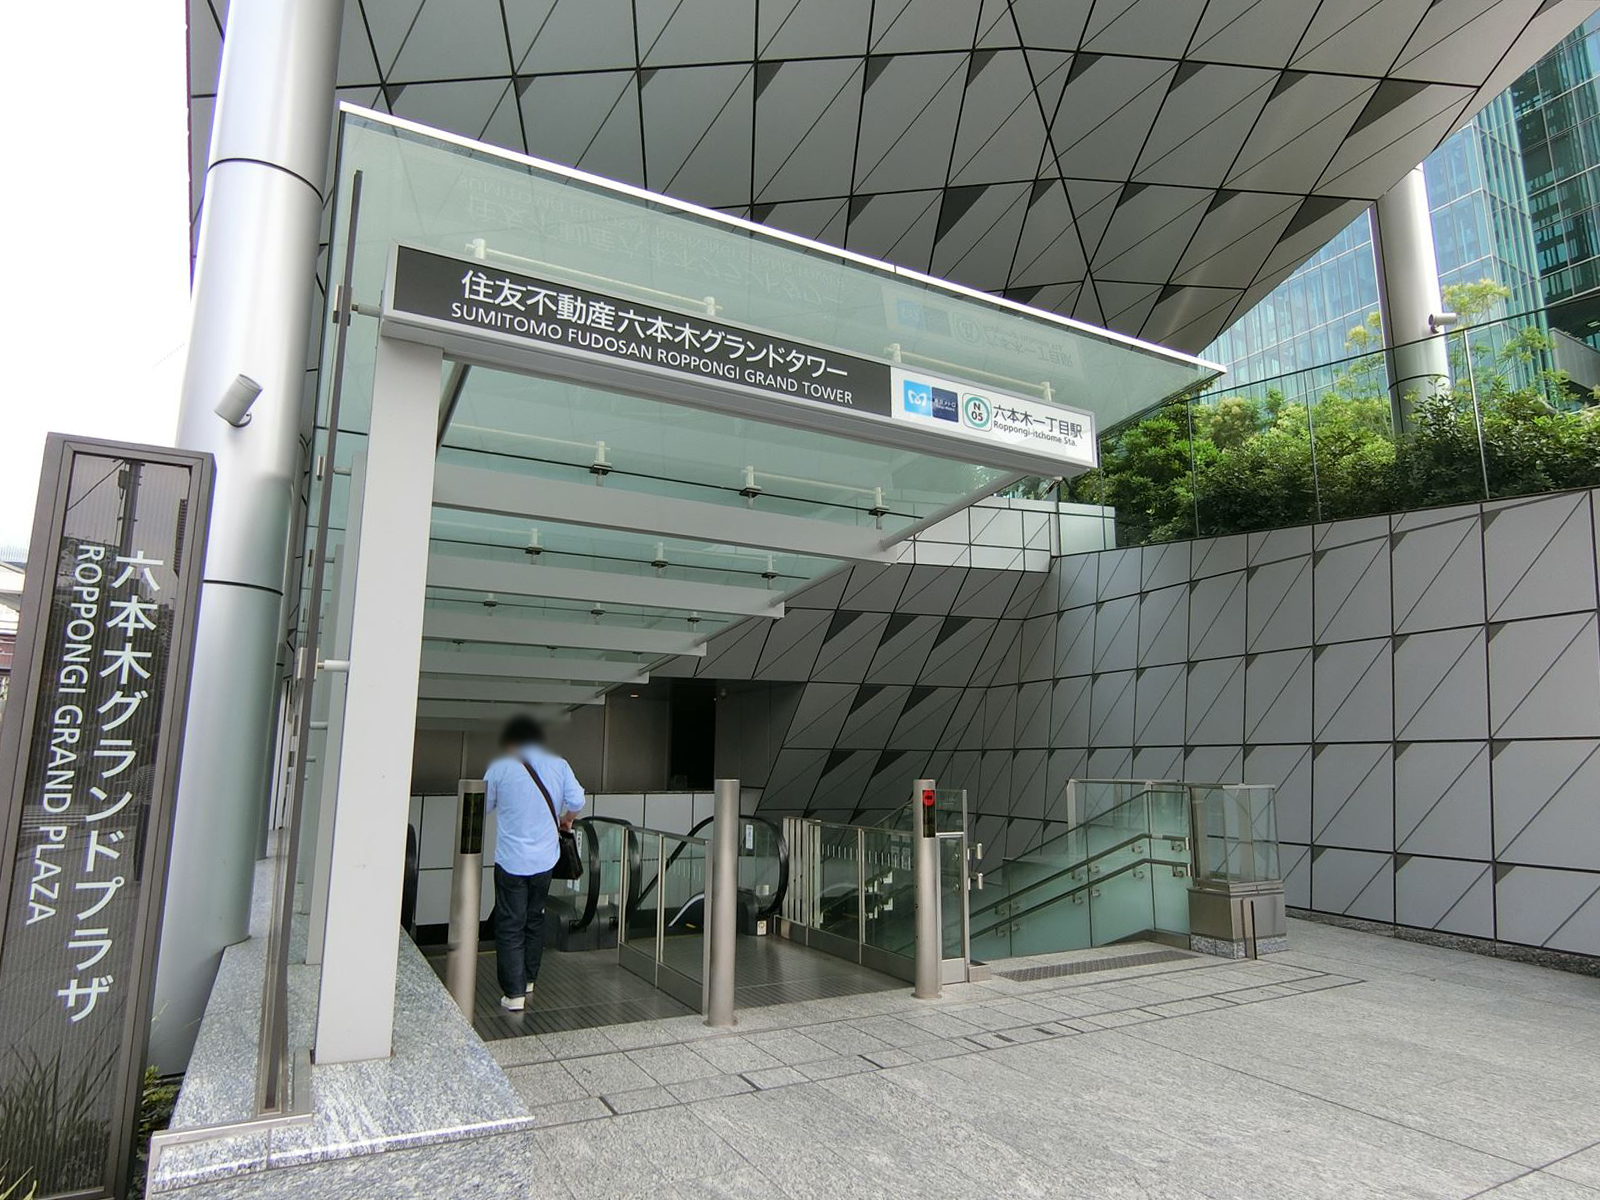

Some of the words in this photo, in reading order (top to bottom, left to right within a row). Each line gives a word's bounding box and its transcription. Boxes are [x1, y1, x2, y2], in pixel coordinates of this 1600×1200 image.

[451, 301, 562, 340] SUMITOMO
[567, 328, 653, 360] FUDOSAN
[656, 348, 740, 380] ROPPONGI
[744, 369, 798, 392] GRAND
[801, 381, 853, 405] TOWER
[461, 269, 848, 378] 住友不動産六本木グランドタワー
[971, 410, 984, 422] 05
[973, 402, 981, 411] N
[993, 404, 1083, 439] 六本木一丁目駅
[993, 420, 1062, 443] Roppongi-itchome
[1063, 437, 1078, 447] Sta.
[58, 544, 106, 694] ROPPONGI
[42, 704, 84, 814] GRAND
[57, 550, 164, 1023] 六本木グランドプラザ
[26, 825, 68, 926] PLAZA
